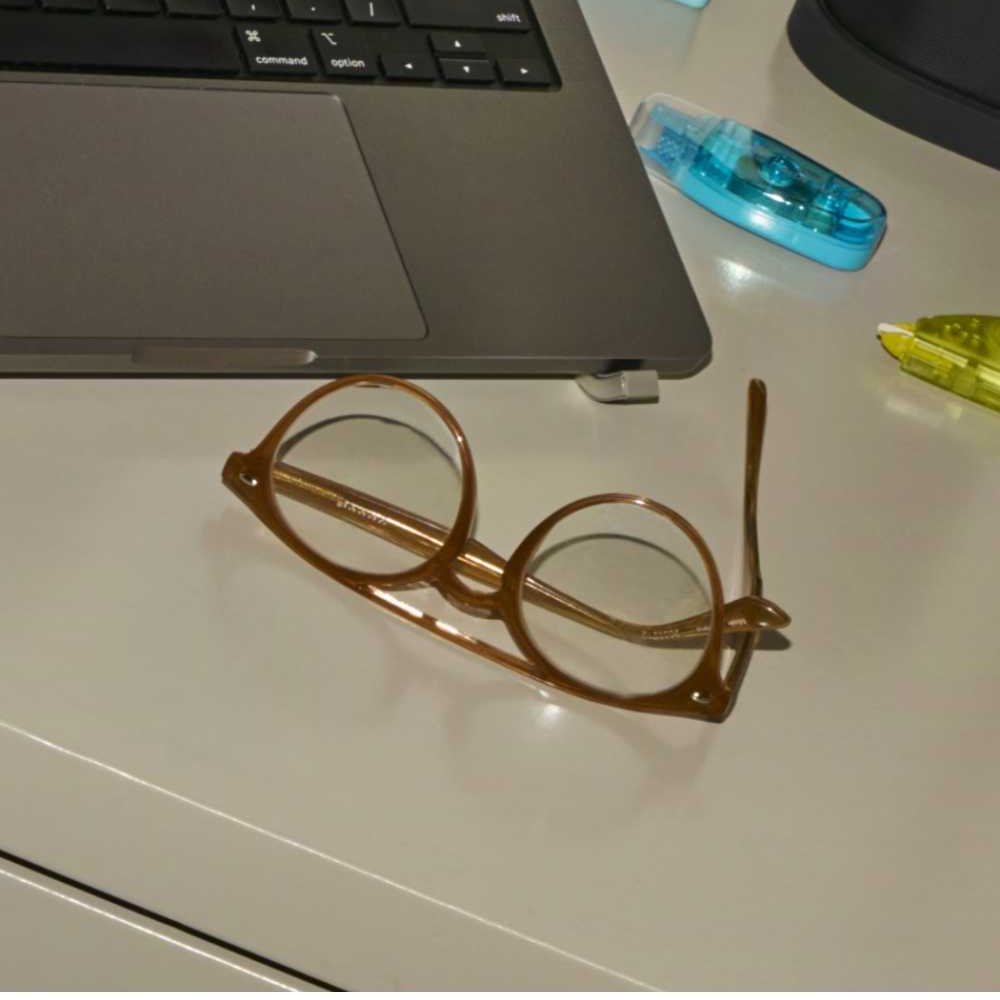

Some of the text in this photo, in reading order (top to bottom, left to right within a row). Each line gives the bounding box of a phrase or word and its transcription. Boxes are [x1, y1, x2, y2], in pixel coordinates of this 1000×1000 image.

[496, 13, 521, 23] shift
[255, 56, 309, 66] command
[330, 57, 366, 69] option
